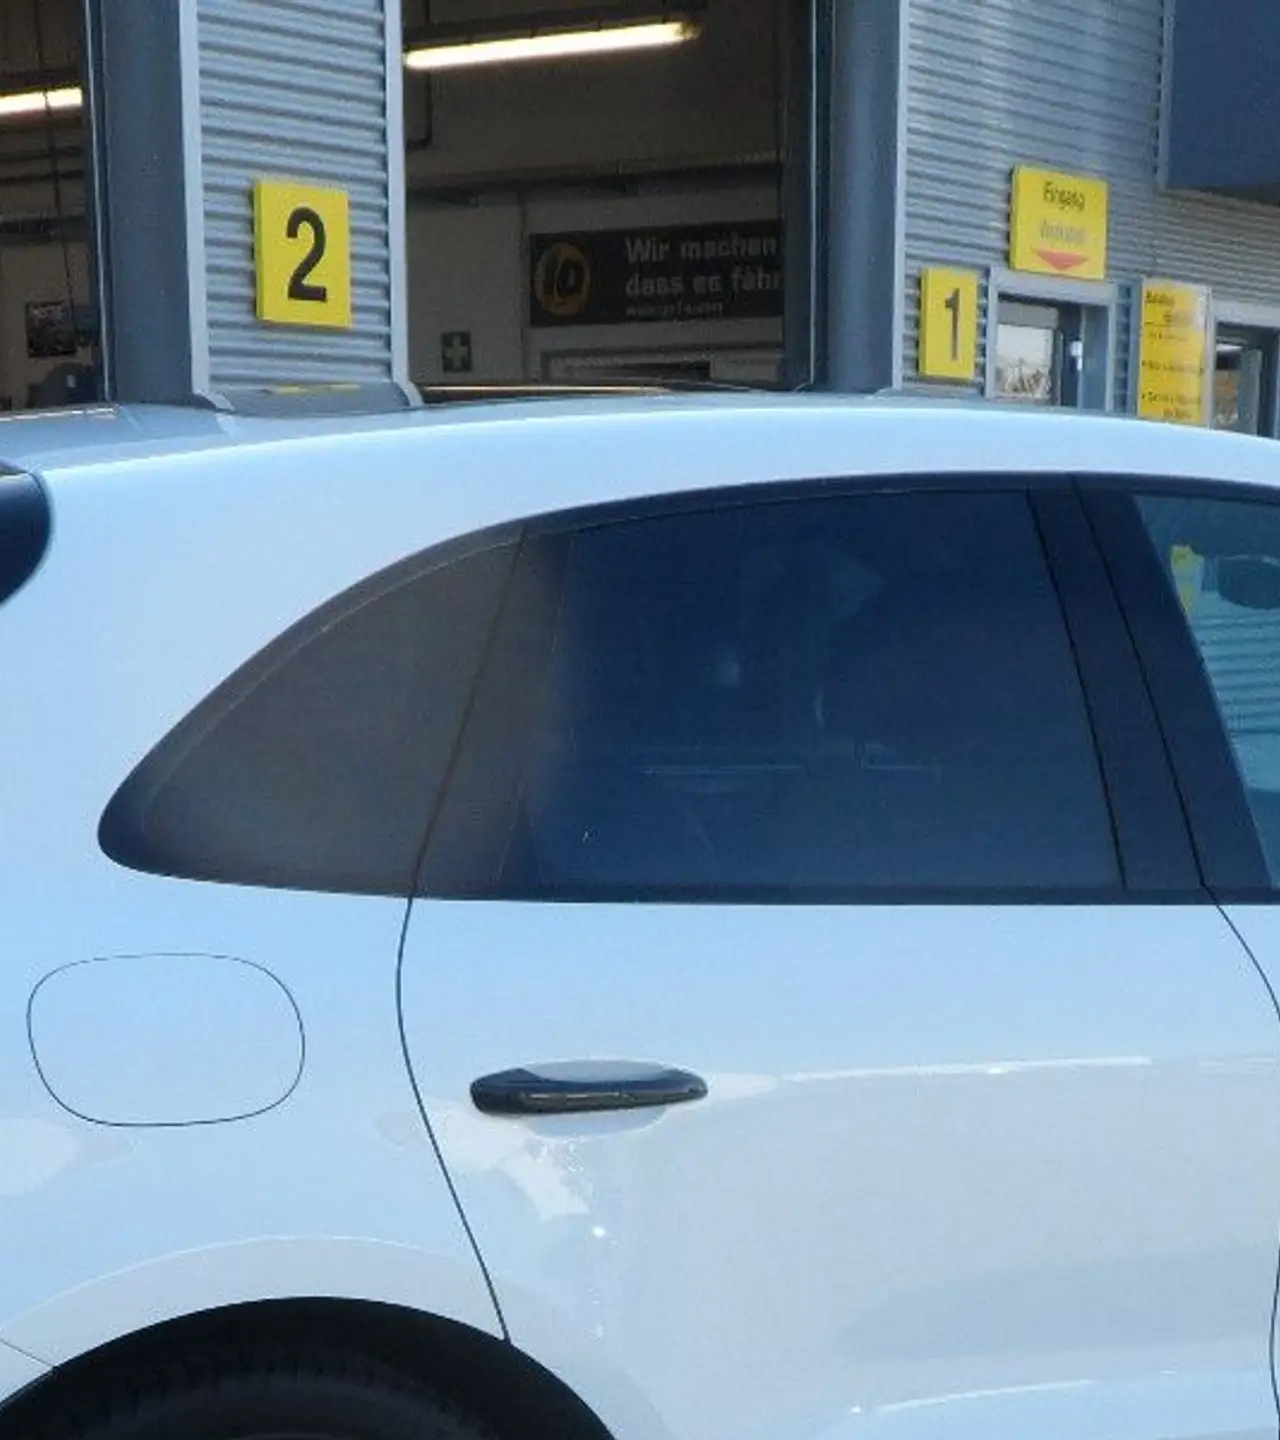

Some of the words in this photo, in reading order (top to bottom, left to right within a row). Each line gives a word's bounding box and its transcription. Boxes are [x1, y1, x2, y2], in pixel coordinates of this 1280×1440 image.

[285, 206, 328, 303] 2
[624, 237, 670, 263] Wir
[943, 287, 962, 363] 1
